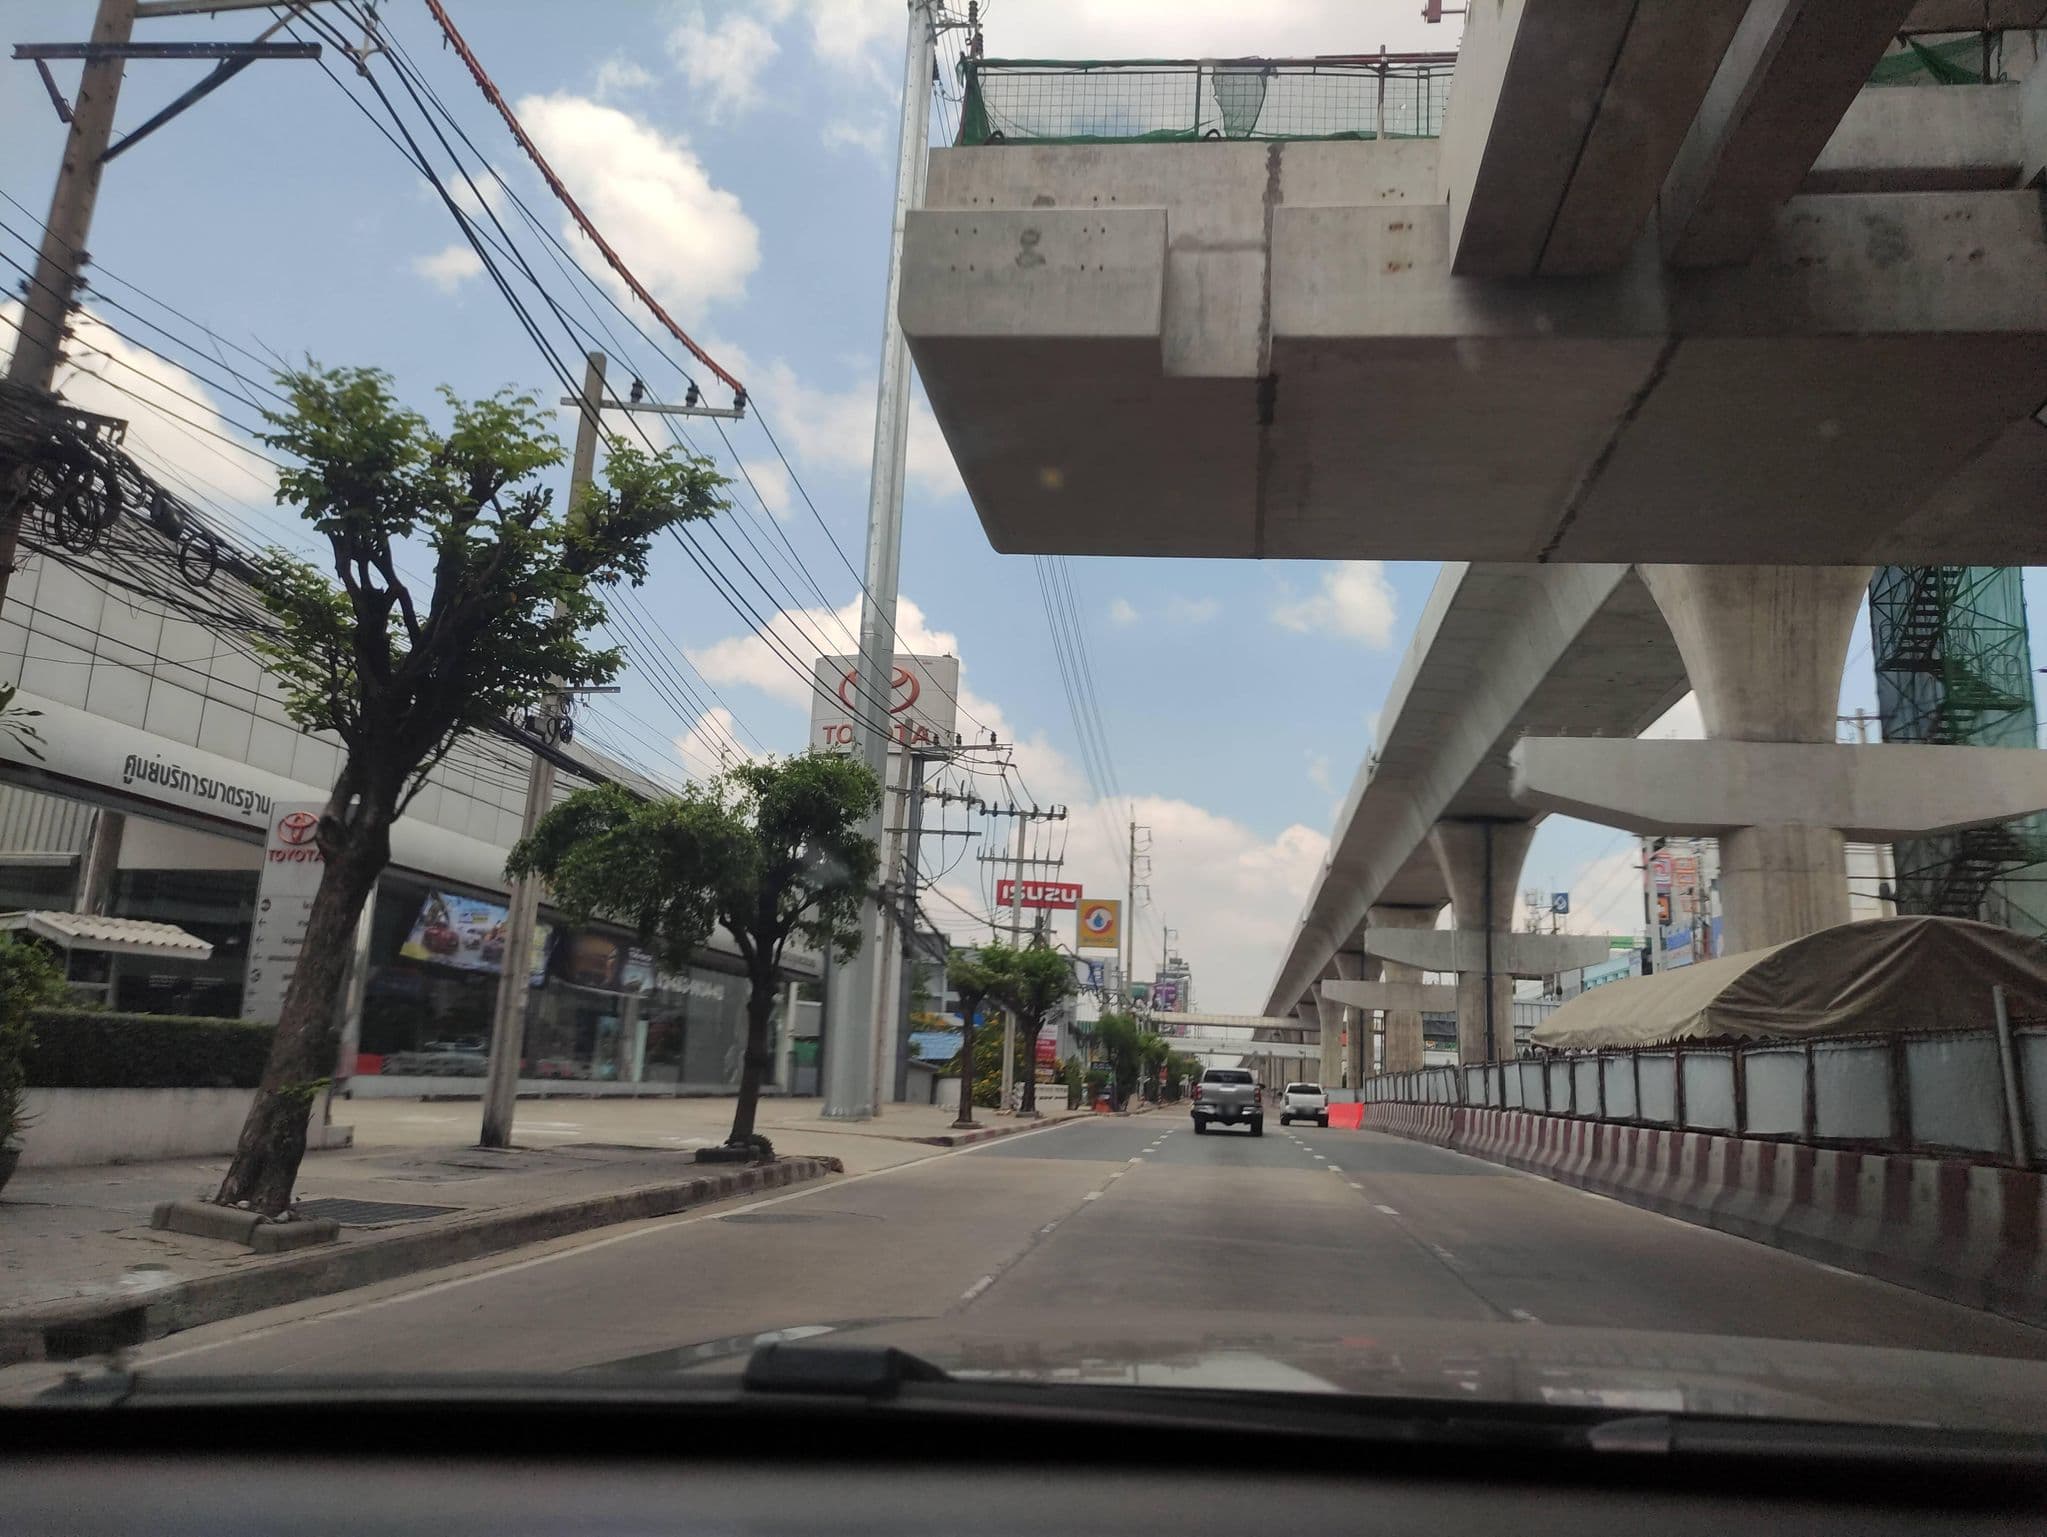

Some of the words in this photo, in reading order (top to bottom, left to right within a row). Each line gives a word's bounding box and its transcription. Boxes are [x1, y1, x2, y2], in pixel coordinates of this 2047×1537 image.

[823, 723, 931, 746] TOTA
[123, 754, 271, 816] ศูนย์บริการมาตรฐาน
[269, 849, 327, 863] TOYOTA
[1002, 885, 1077, 903] ISUZU
